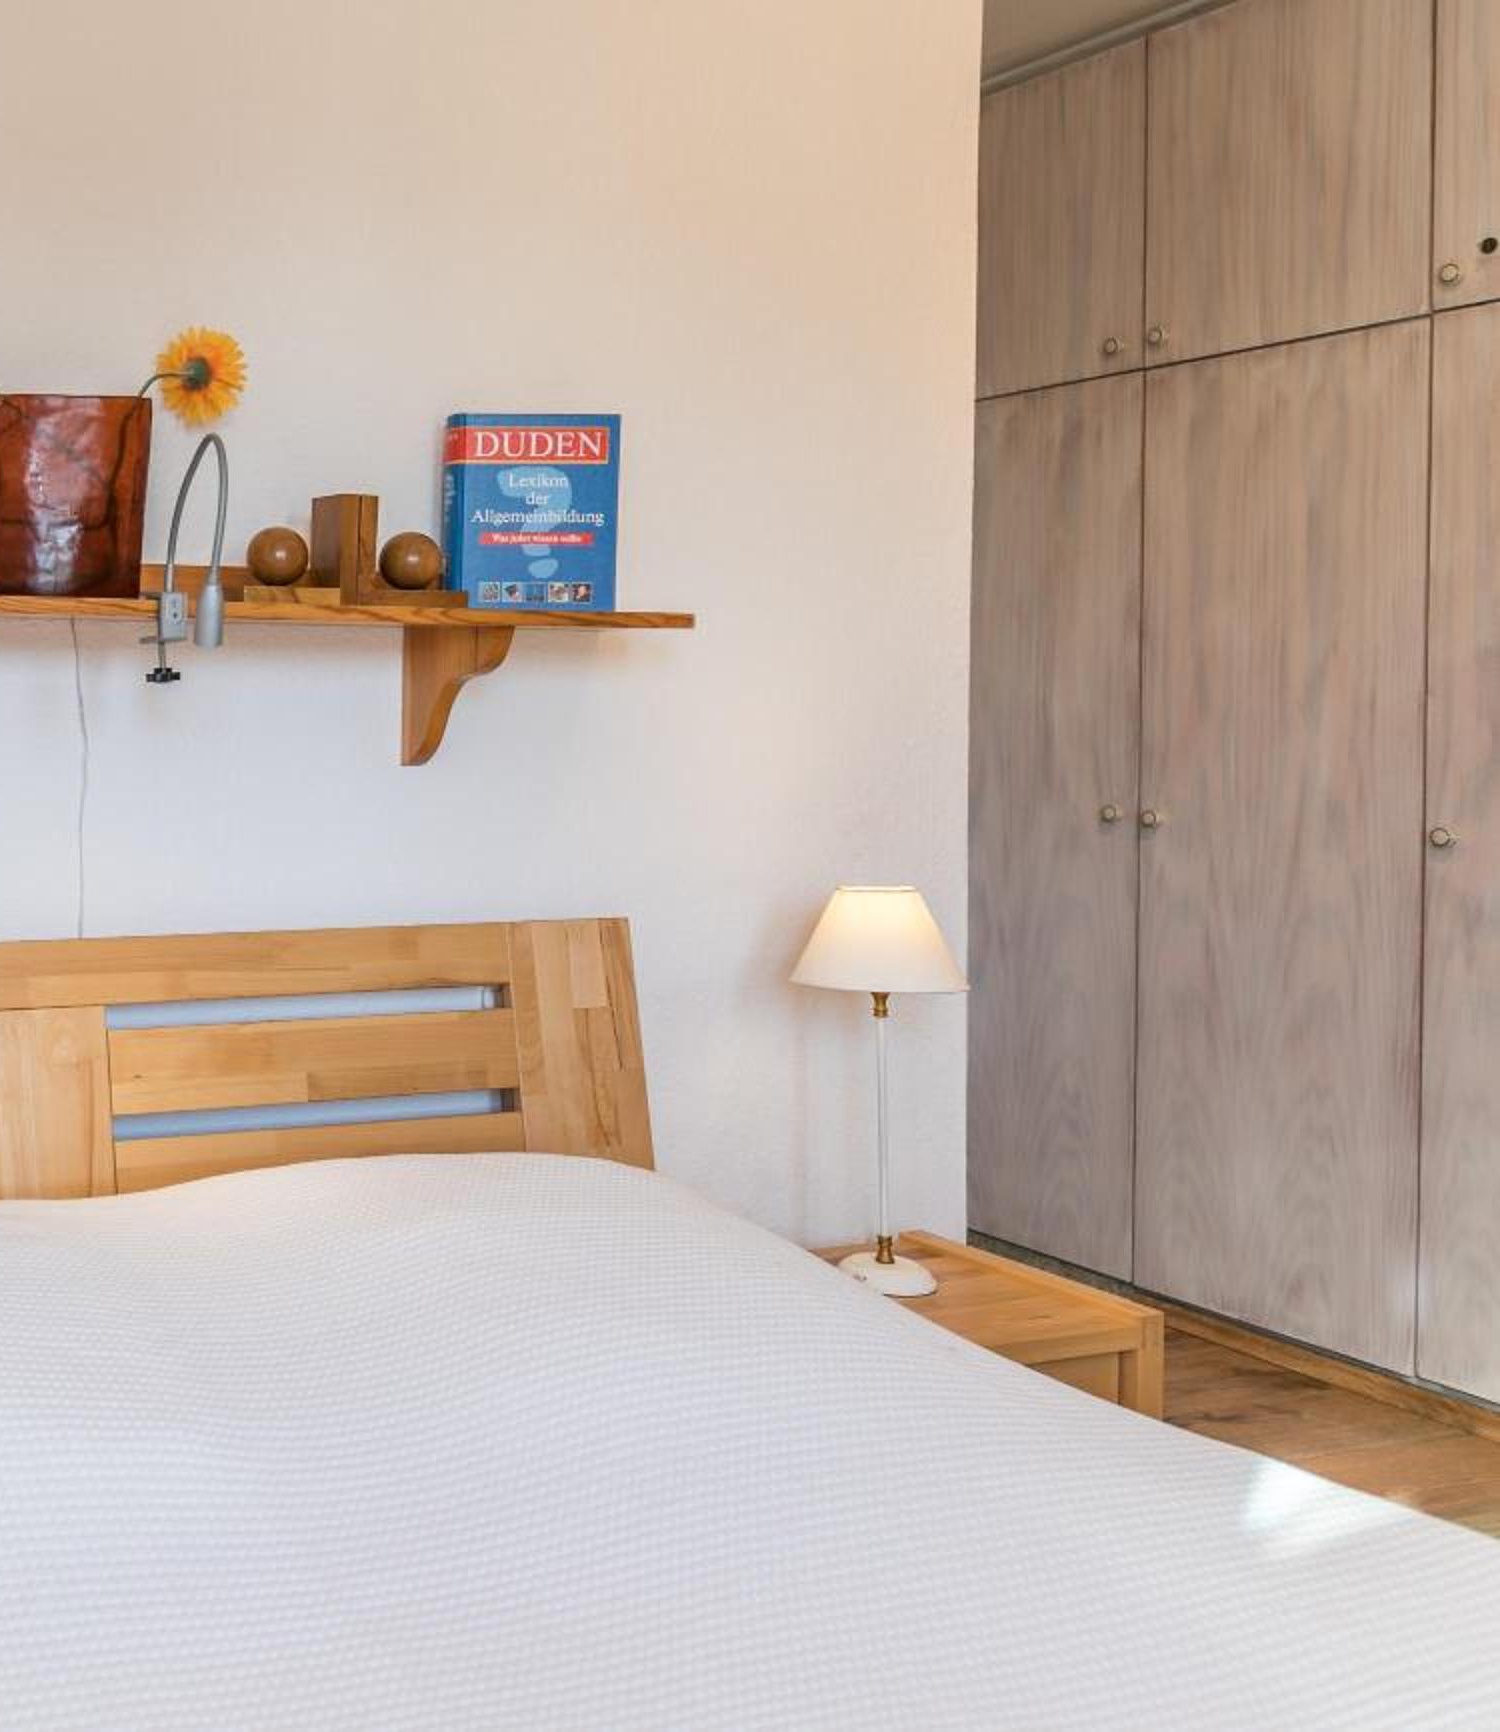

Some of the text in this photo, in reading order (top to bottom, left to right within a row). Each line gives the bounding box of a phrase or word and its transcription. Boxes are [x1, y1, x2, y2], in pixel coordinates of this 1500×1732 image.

[474, 431, 603, 457] DUDEN
[509, 474, 569, 487] Lexikon
[526, 492, 549, 505] der
[471, 510, 605, 526] Allgemeinbildung
